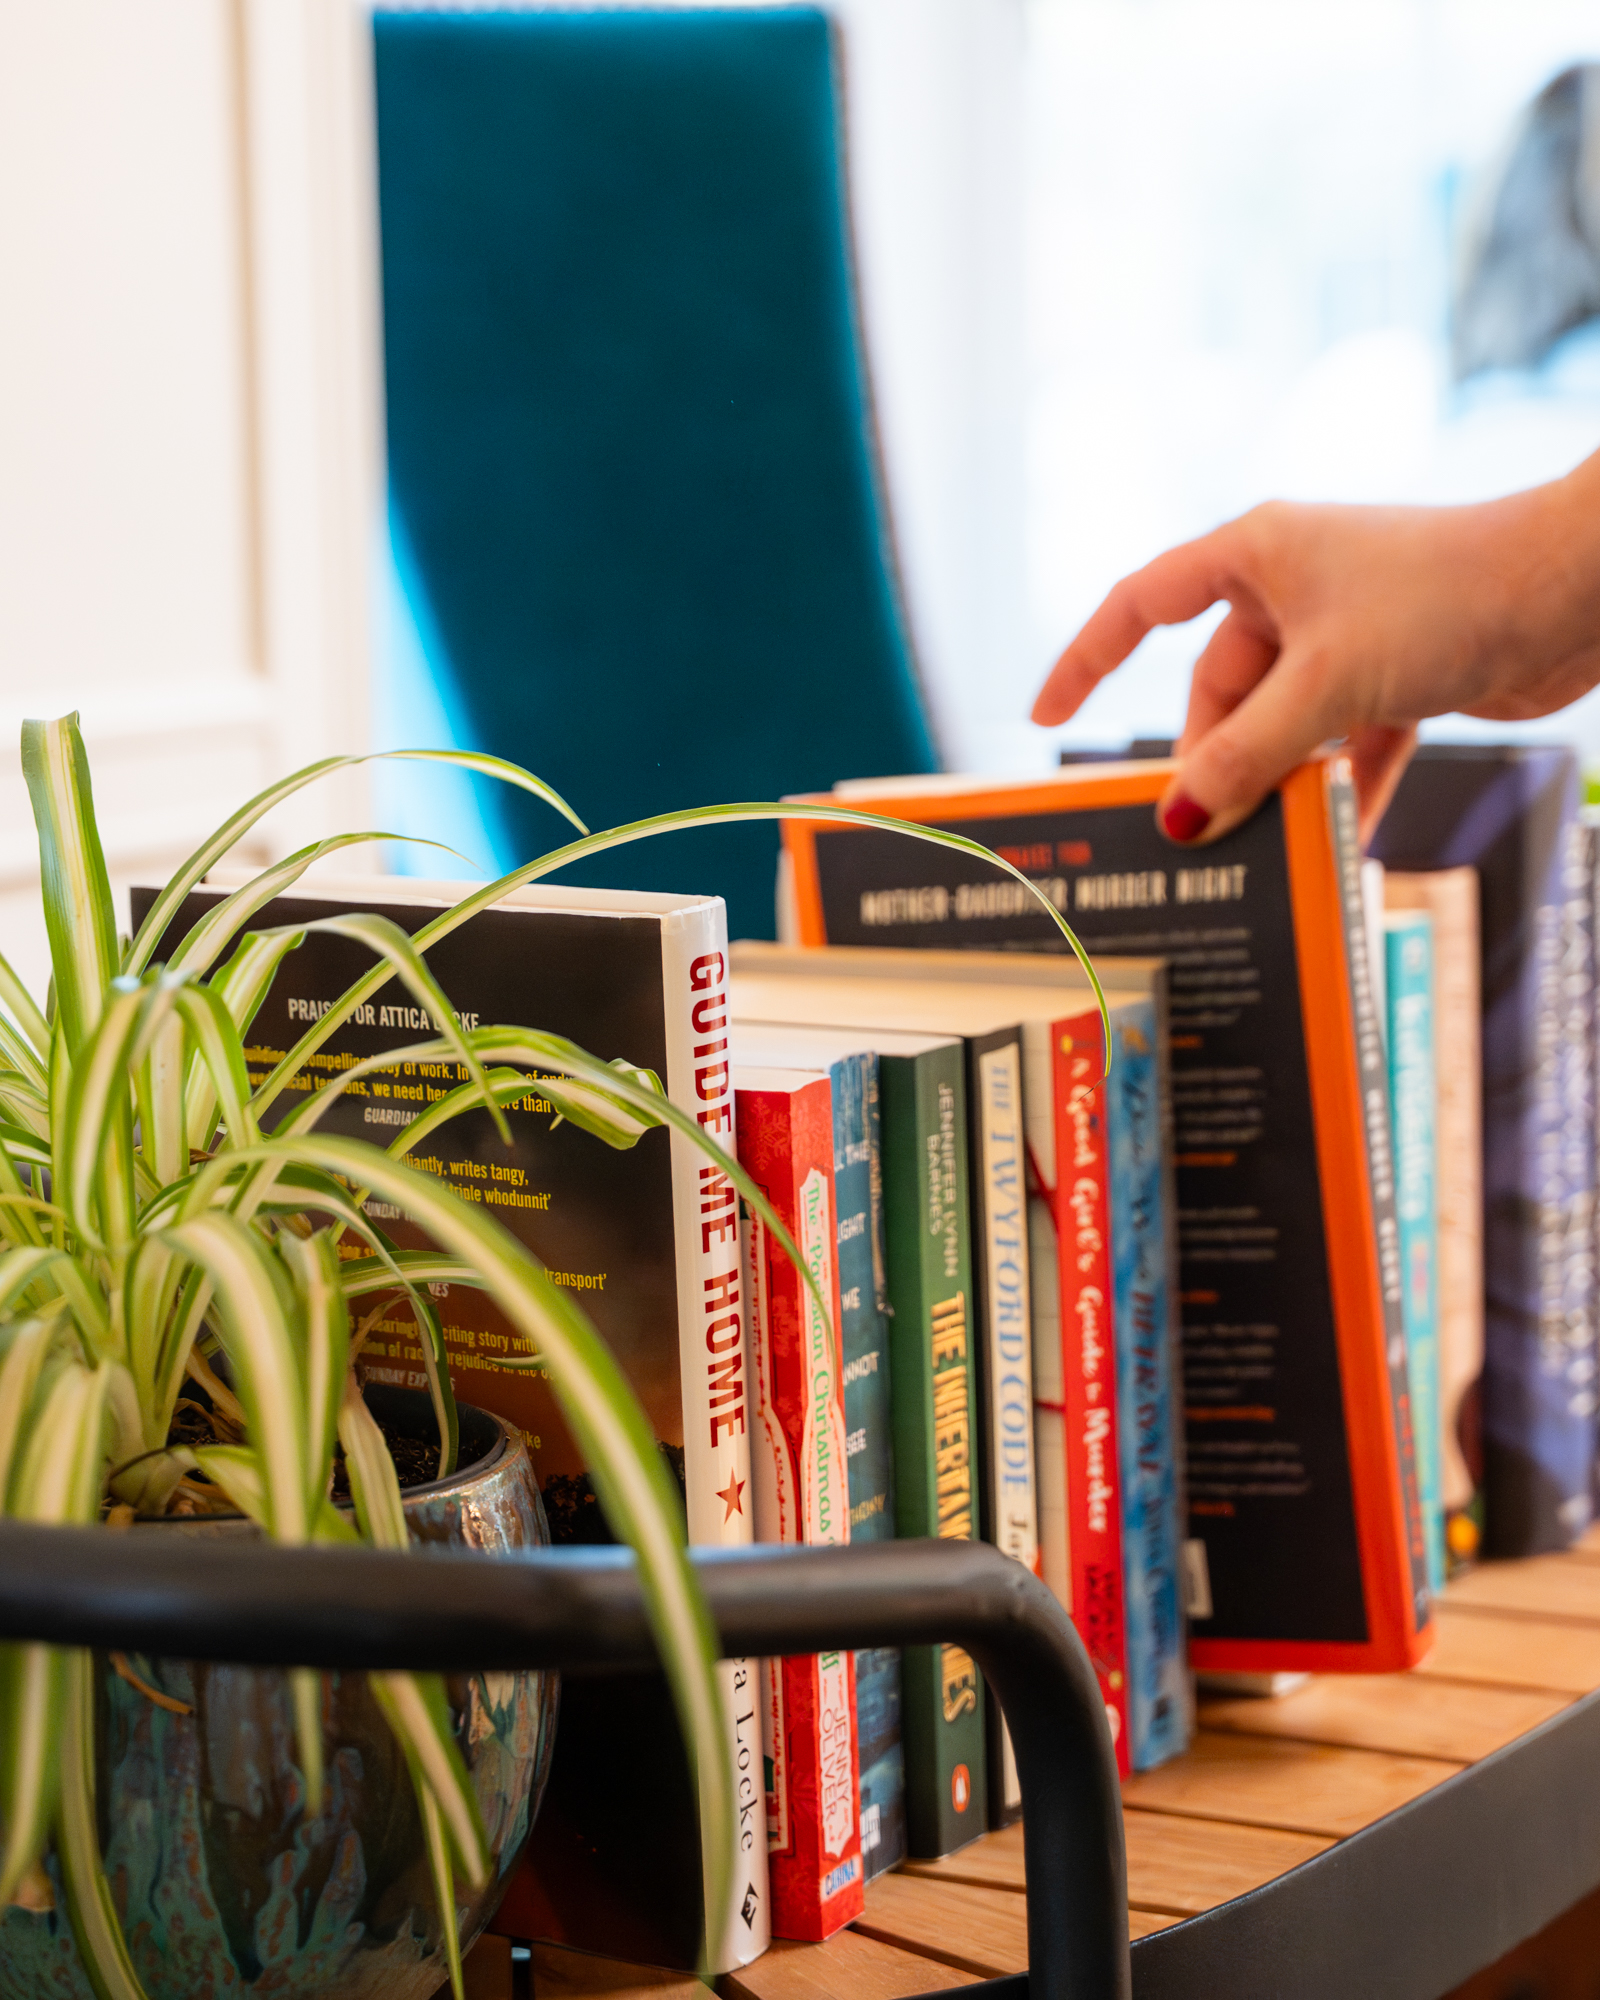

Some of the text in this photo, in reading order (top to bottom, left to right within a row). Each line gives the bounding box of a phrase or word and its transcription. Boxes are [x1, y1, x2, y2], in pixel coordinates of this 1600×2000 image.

[288, 998, 334, 1022] PRAIS
[380, 1006, 430, 1030] ATTICA
[433, 1010, 480, 1032] LCKE
[305, 1050, 366, 1073] ompelling
[404, 1061, 417, 1077] of
[420, 1062, 454, 1079] work.
[457, 1063, 469, 1081] In
[373, 1083, 390, 1098] we
[393, 1083, 424, 1101] need
[427, 1084, 447, 1102] her
[523, 1096, 551, 1113] than
[401, 1153, 529, 1186] lliantly, writes tangy,
[484, 1187, 551, 1211] whodunnit'
[690, 951, 745, 1448] GUIDE ME HOME
[926, 1133, 943, 1236] BARNES
[938, 1082, 959, 1278] JENNIFER LYNN
[991, 1124, 1025, 1362] TWYFORD
[443, 1325, 475, 1348] citing
[478, 1331, 509, 1353] story
[447, 1349, 500, 1373] rejudice
[807, 1178, 820, 1226] The
[814, 1370, 832, 1533] Christmas
[1001, 1374, 1031, 1498] CODE
[1083, 1407, 1113, 1533] Murder
[931, 1291, 977, 1724] THE INHERITAN MES
[735, 1711, 758, 1852] Locke
[821, 1708, 838, 1822] OLIVER
[834, 1706, 850, 1802] JENNY
